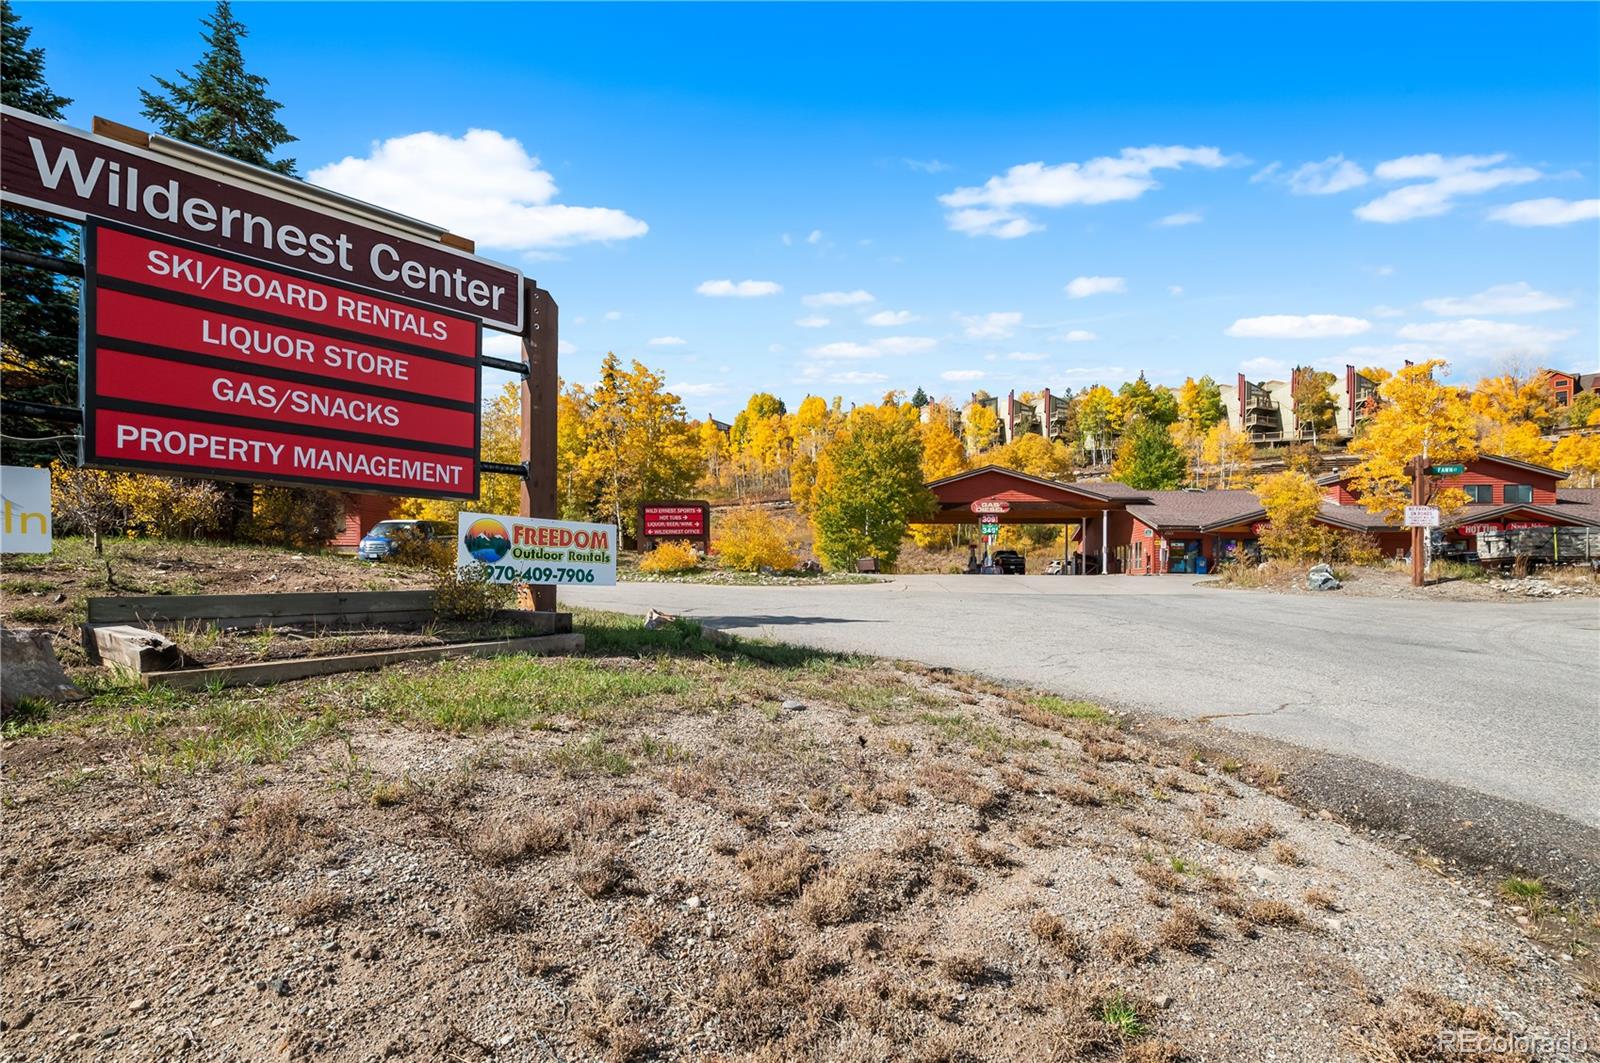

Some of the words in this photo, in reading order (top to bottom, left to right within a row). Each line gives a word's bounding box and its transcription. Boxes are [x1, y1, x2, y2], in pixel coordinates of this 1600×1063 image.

[29, 137, 354, 272] Wildernest
[370, 243, 505, 311] Center
[147, 250, 328, 312] SKI/BOARD
[338, 296, 448, 341] RENTALS
[202, 320, 315, 363] LIQUOR
[324, 345, 409, 381] STORE
[212, 378, 400, 427] GAS/SNACKS
[117, 425, 285, 465] PROPERTY
[294, 446, 463, 485] MANAGEMENT
[512, 524, 609, 550] FREEDOM
[1465, 524, 1481, 534] HOT
[486, 565, 595, 583] 970-409-7906
[512, 548, 564, 561] Outdoor
[568, 550, 611, 563] Rentals
